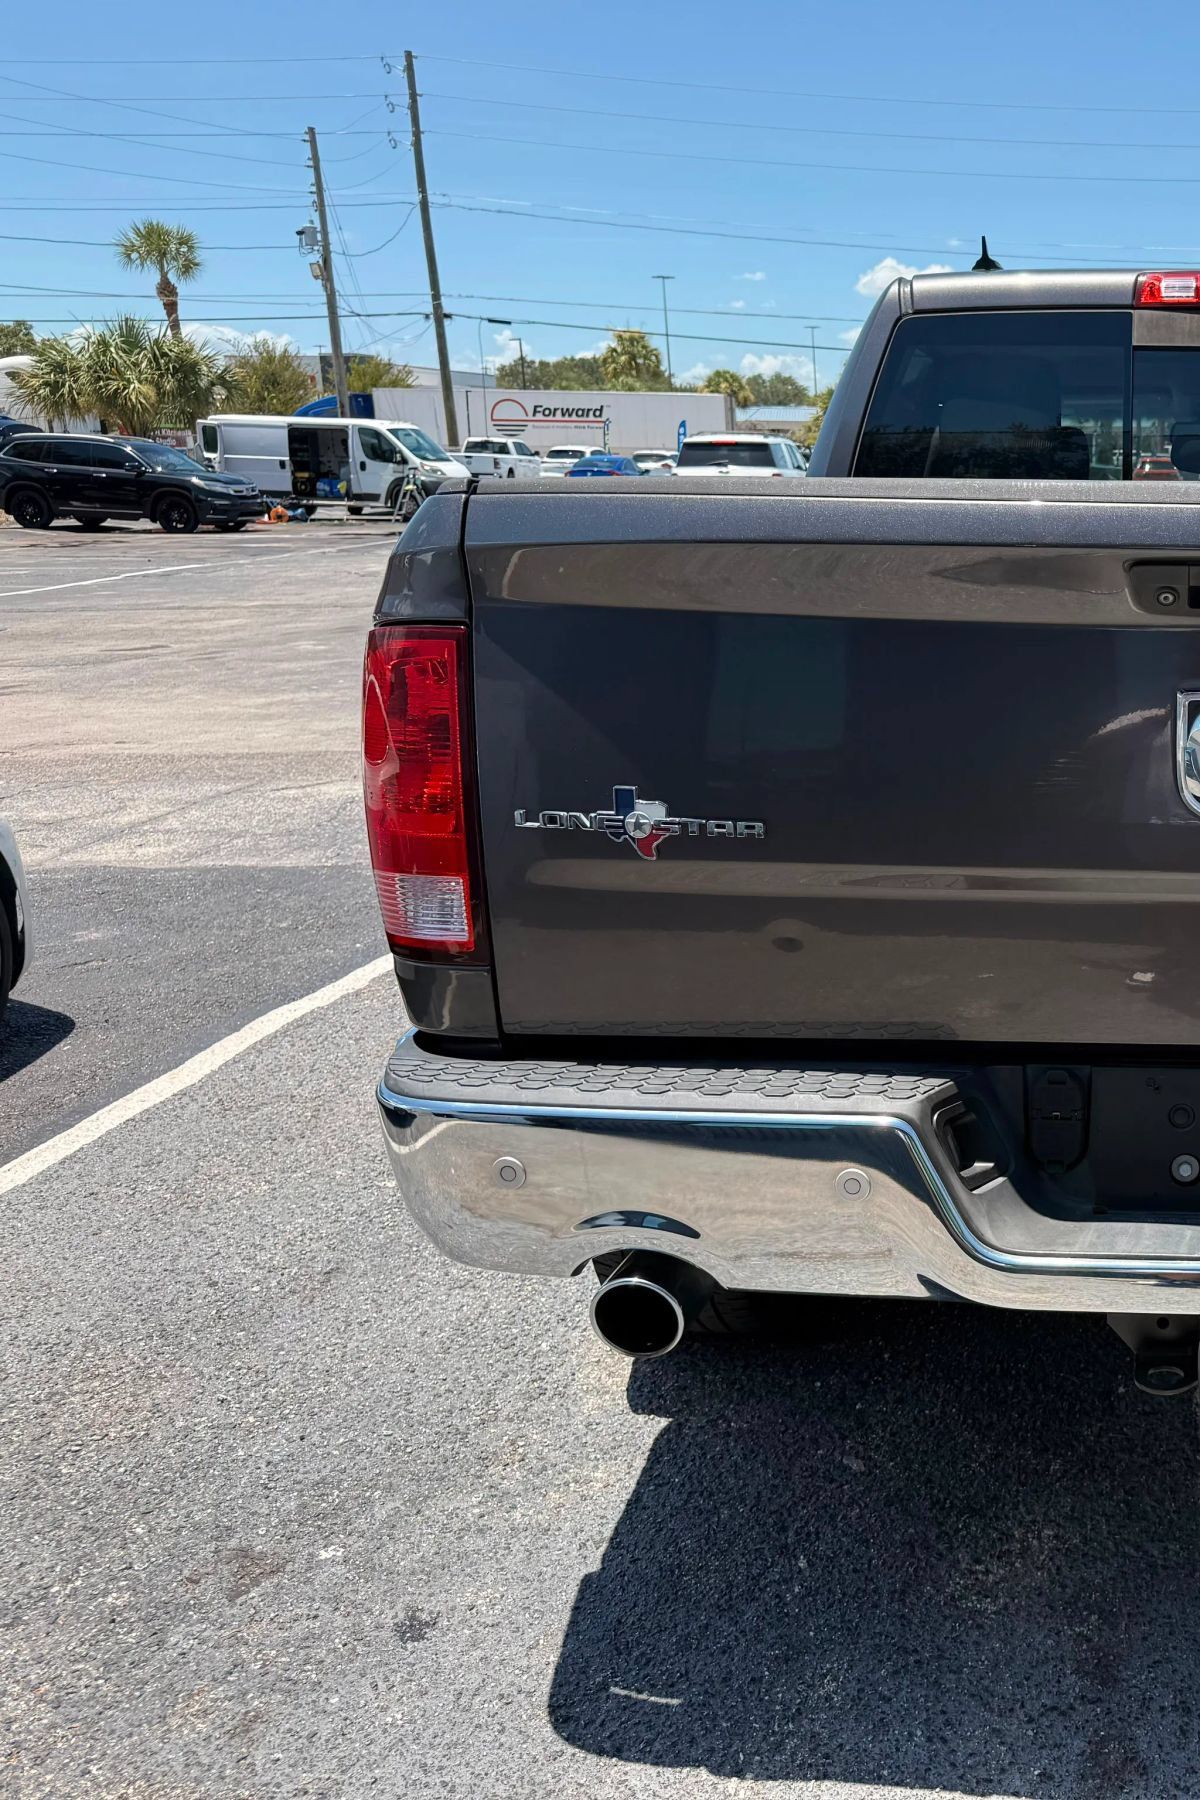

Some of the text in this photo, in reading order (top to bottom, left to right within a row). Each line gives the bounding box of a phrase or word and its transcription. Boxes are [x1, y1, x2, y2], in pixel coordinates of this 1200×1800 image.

[532, 404, 604, 418] Forward
[514, 808, 767, 839] LONE STAR
